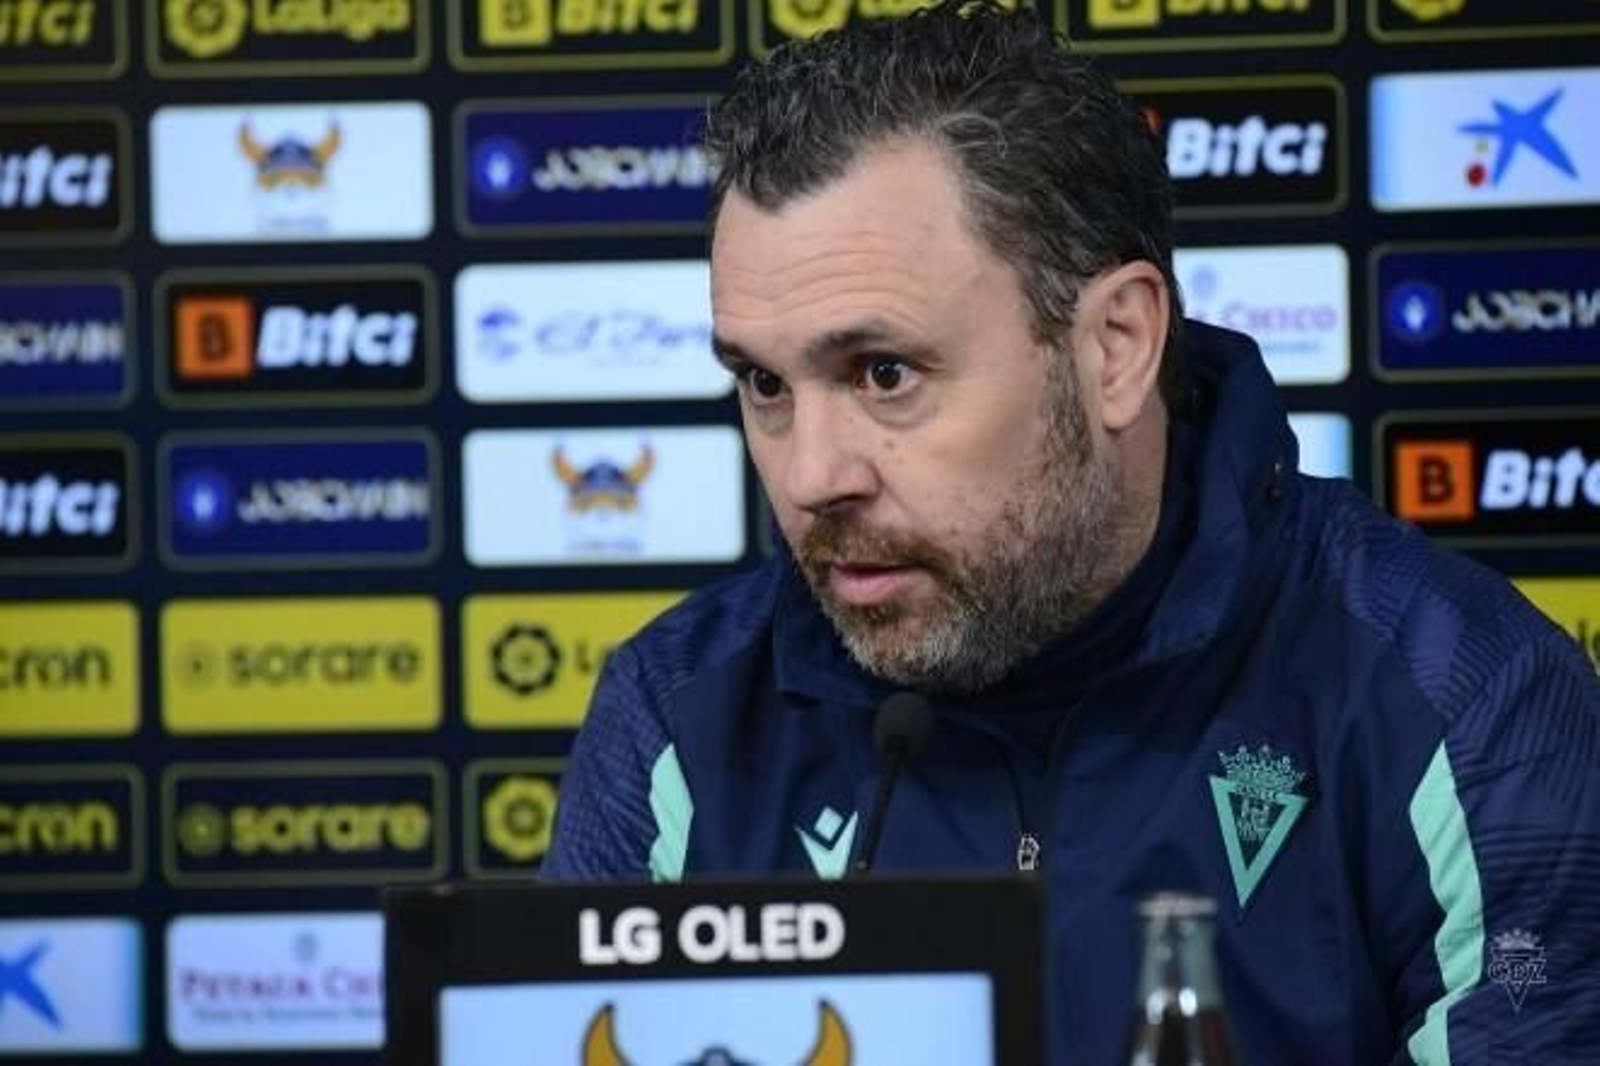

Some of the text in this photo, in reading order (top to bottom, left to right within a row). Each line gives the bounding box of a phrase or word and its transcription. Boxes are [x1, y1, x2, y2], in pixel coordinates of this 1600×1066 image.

[0, 145, 113, 207] itci
[1167, 116, 1327, 177] Bitci
[257, 306, 417, 367] Bitci
[0, 474, 119, 537] itci
[229, 642, 420, 687] sorare
[230, 803, 431, 853] sorare
[578, 903, 846, 965] LG OLED
